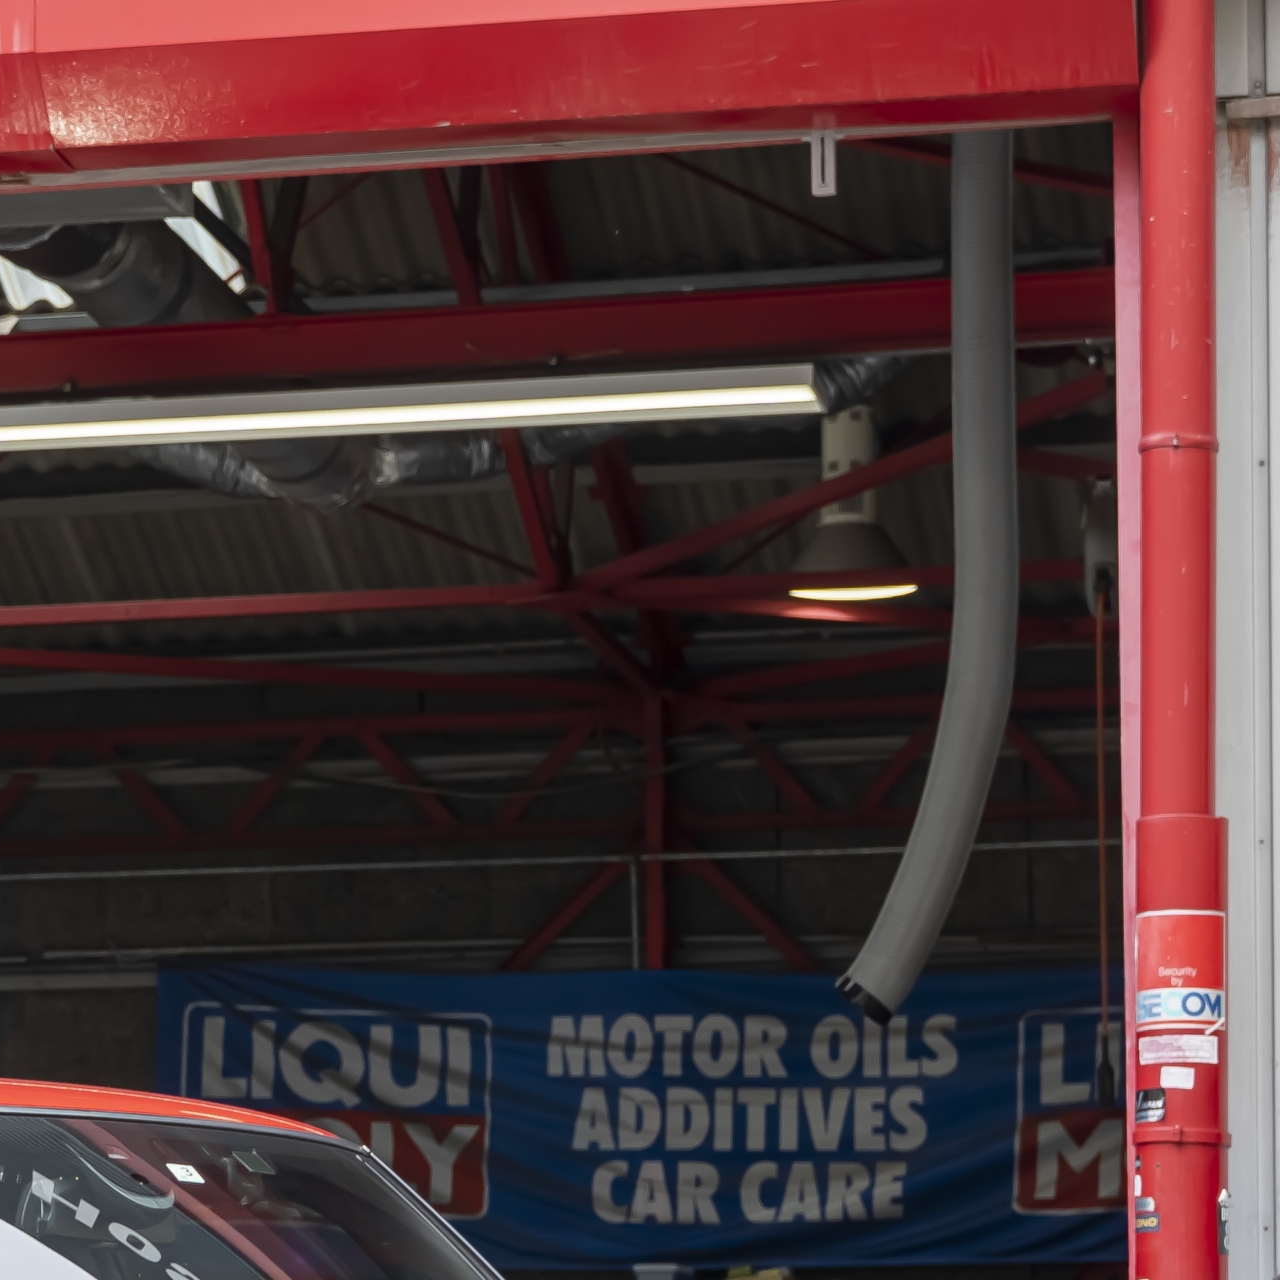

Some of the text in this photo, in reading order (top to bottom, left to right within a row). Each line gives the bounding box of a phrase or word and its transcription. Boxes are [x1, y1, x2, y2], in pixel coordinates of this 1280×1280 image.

[1158, 966, 1197, 977] Security
[1170, 976, 1183, 987] by
[1137, 992, 1222, 1021] SECOM
[201, 1015, 472, 1108] LIQUI
[547, 1013, 959, 1079] MOTOR OILS
[572, 1086, 927, 1152] ADDITIVES
[592, 1160, 907, 1224] CAR CARE
